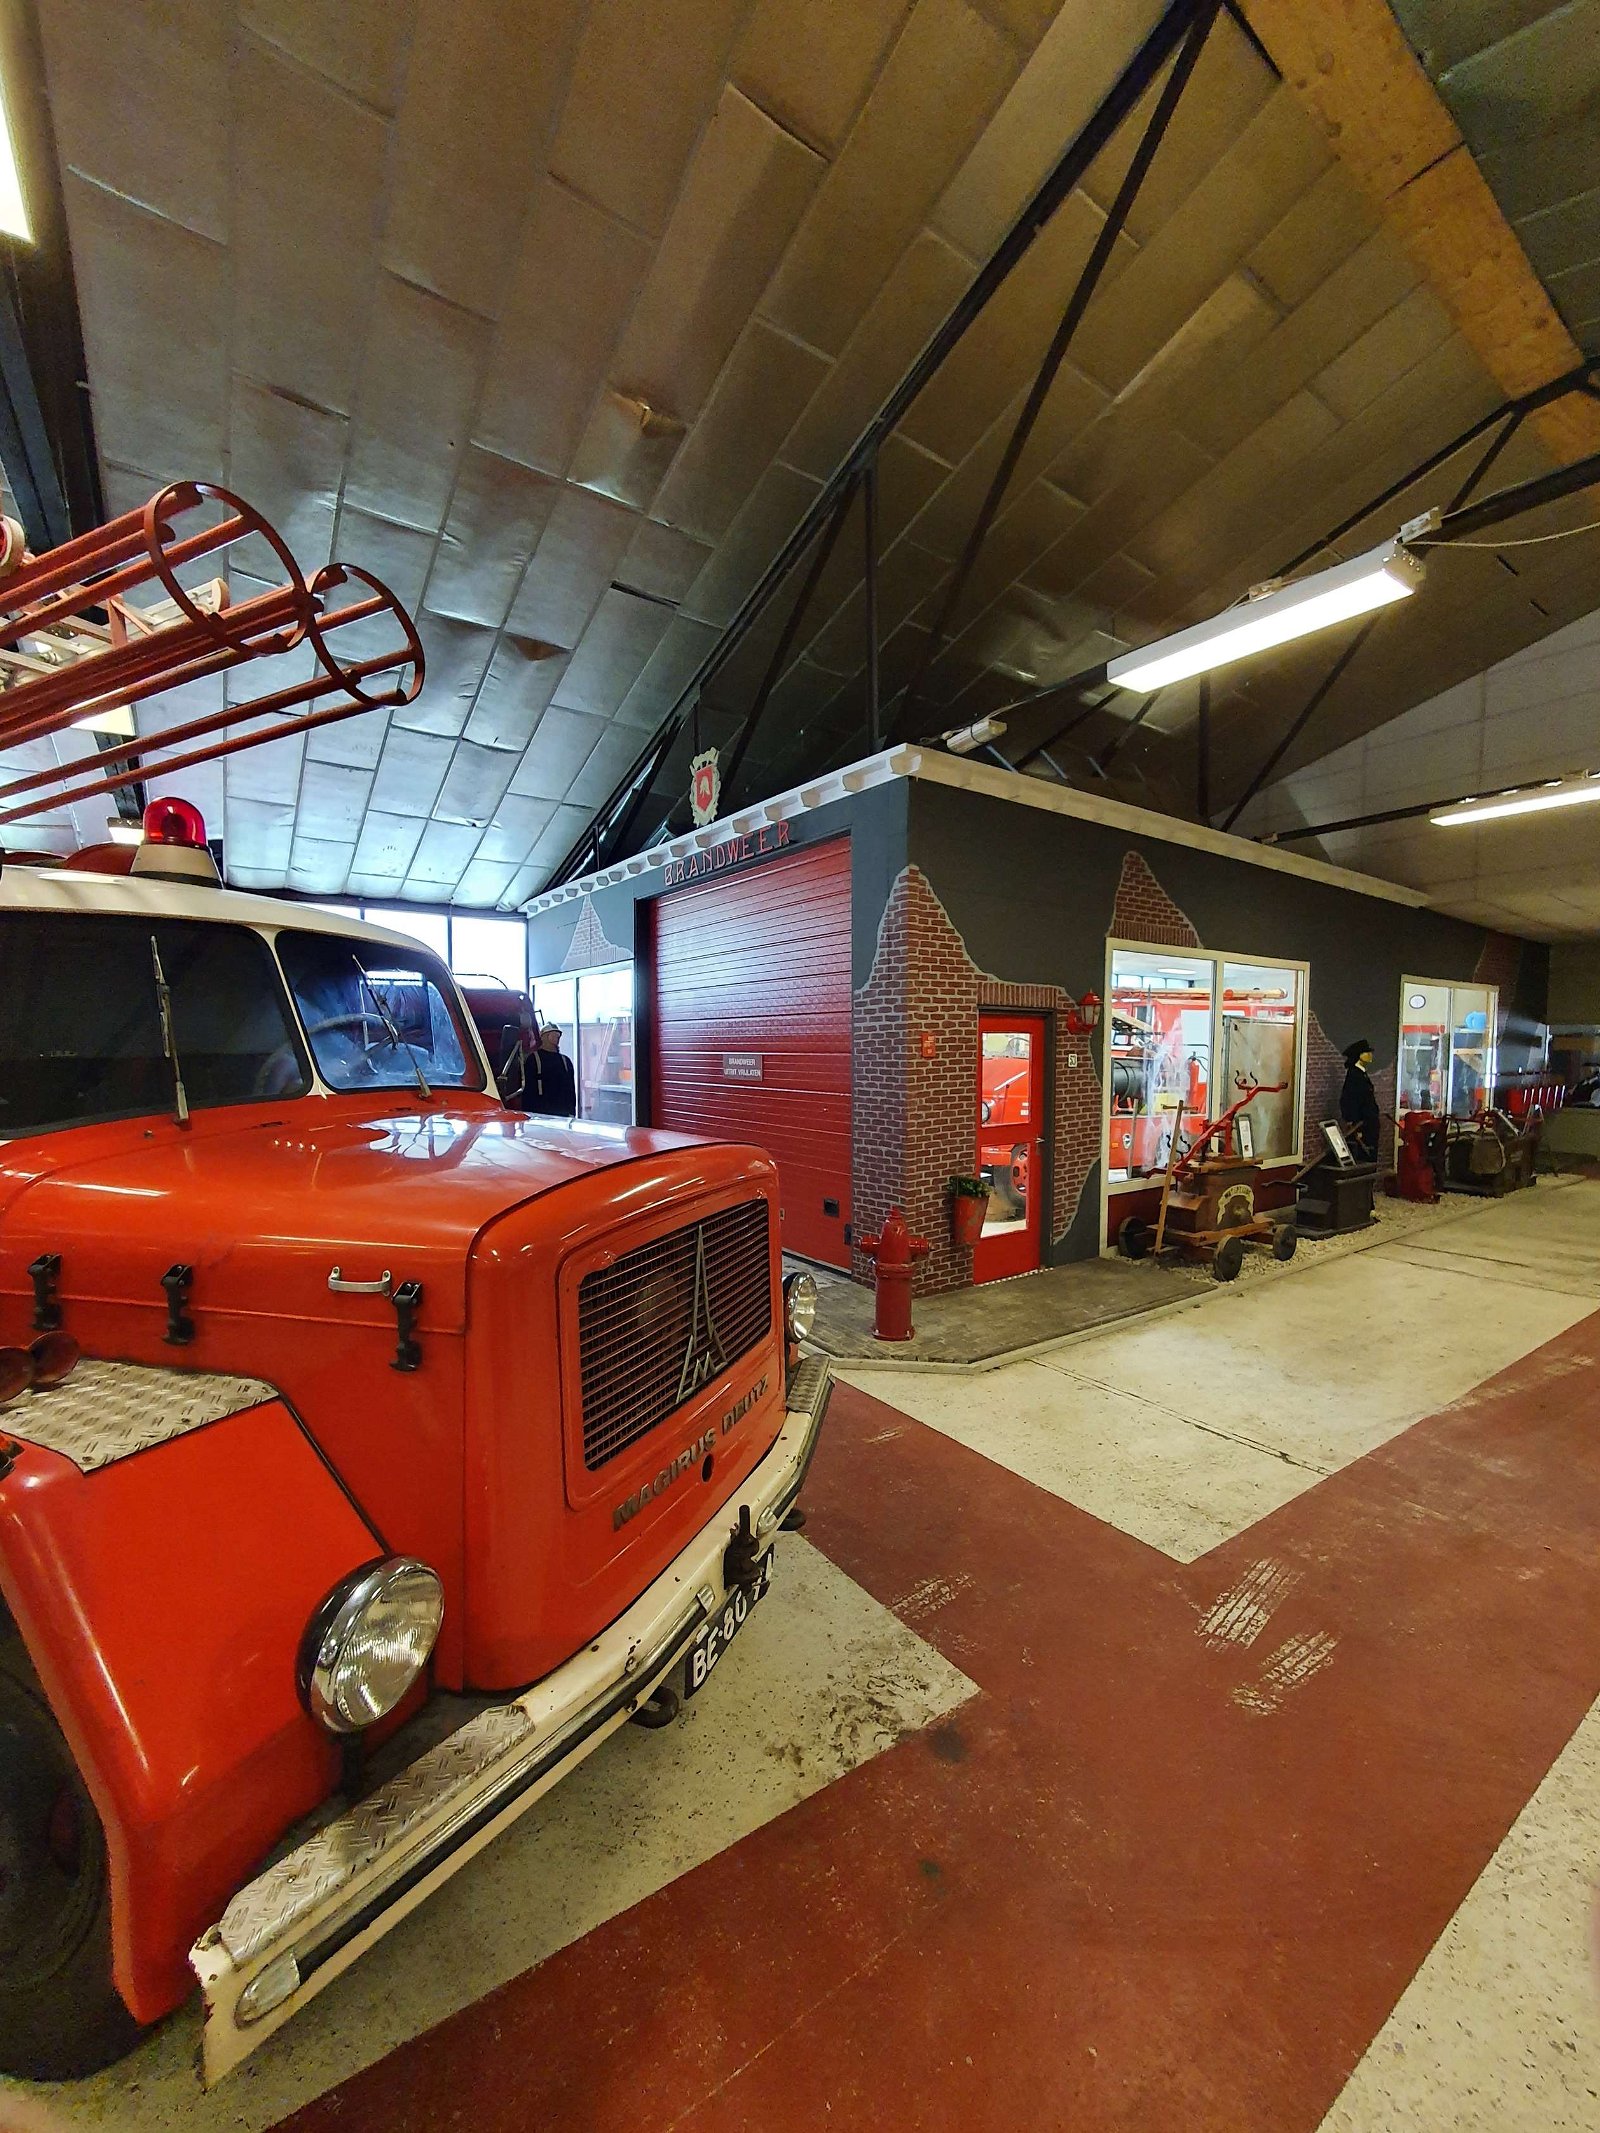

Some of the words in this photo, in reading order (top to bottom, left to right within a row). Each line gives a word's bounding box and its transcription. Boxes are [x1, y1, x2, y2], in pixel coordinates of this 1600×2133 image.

[664, 819, 790, 886] BRANDWEER
[728, 1058, 755, 1066] BRANDWEER
[613, 1427, 716, 1532] MAGIRUS
[721, 1373, 769, 1436] DEUTZ
